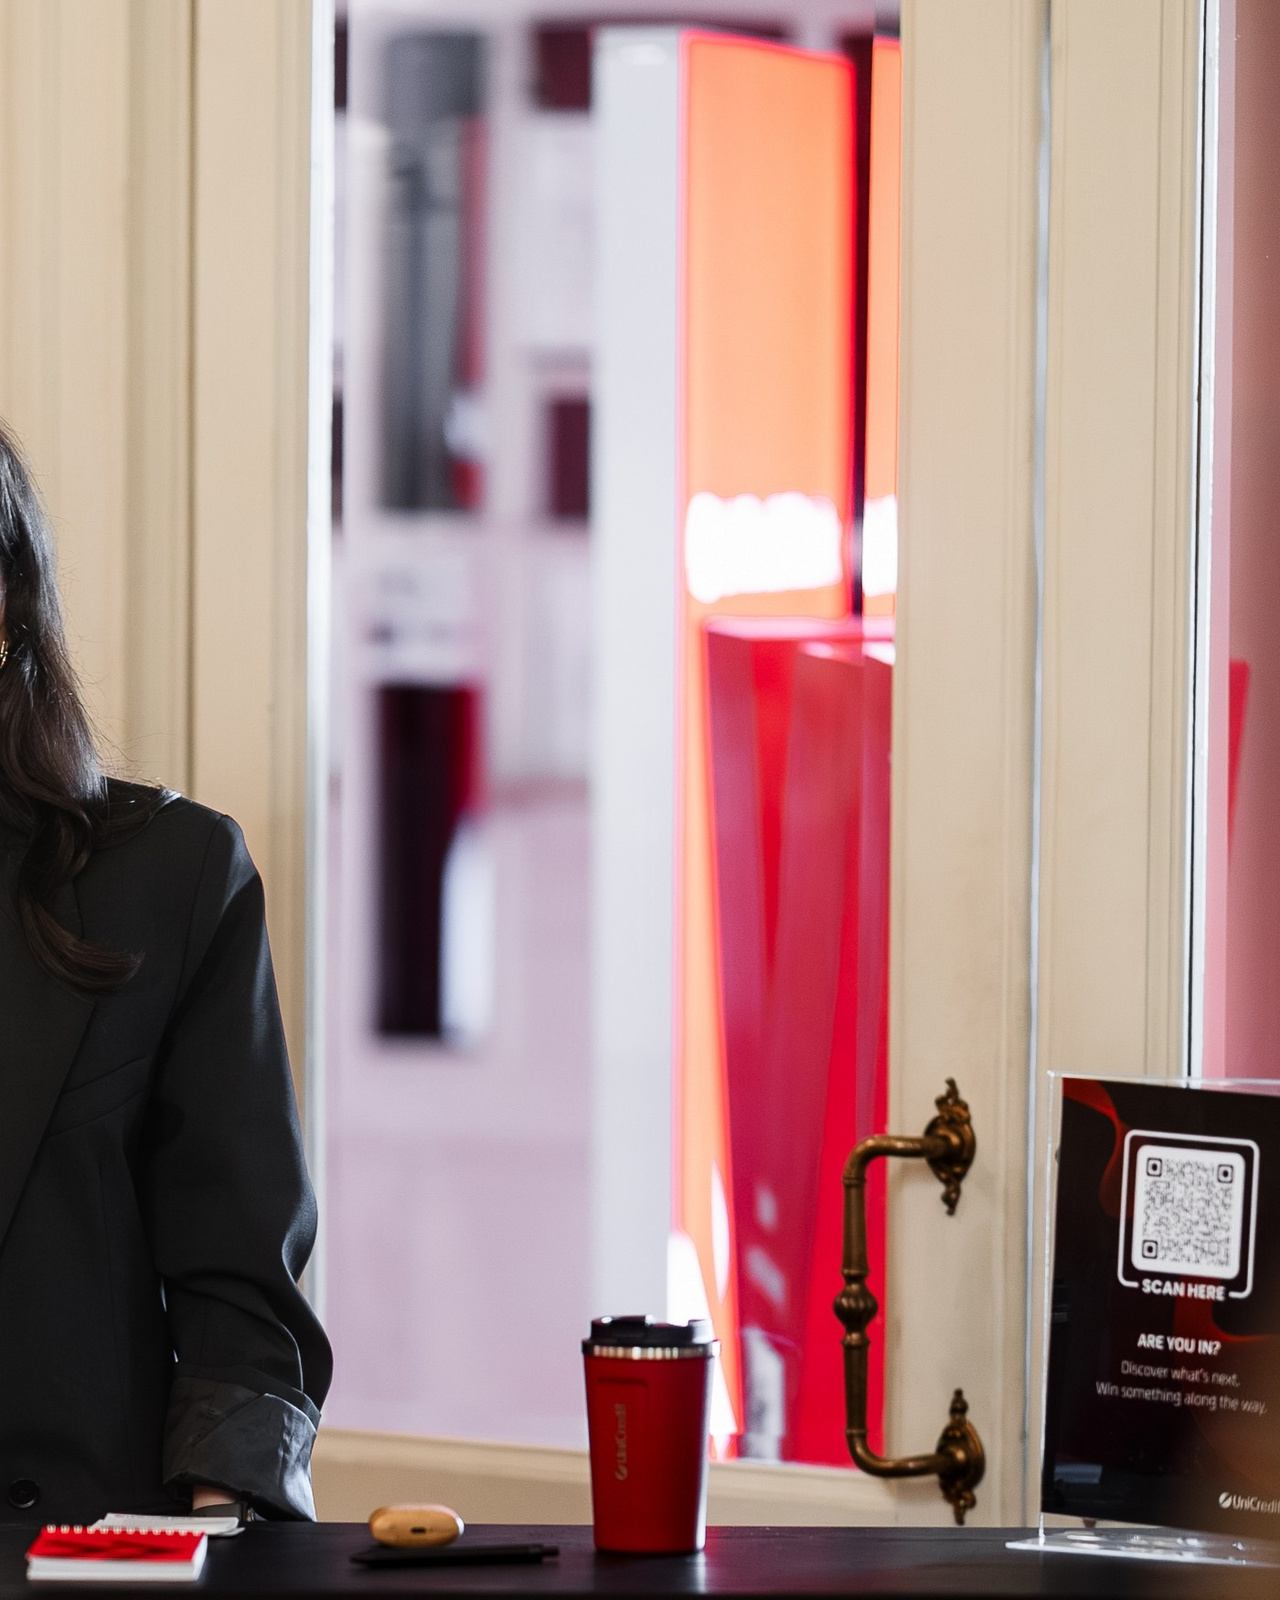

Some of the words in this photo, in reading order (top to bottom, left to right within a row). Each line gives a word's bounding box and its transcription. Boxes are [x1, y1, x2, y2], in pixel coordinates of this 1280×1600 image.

[1142, 1278, 1186, 1298] SCAN
[1187, 1283, 1226, 1301] HERE
[1137, 1333, 1165, 1350] ARE
[1167, 1336, 1196, 1354] YOU
[1198, 1340, 1221, 1356] IN?
[1121, 1360, 1169, 1378] Discover
[1211, 1373, 1241, 1388] next.
[1096, 1381, 1119, 1397] Win
[1121, 1385, 1183, 1407] something
[1184, 1392, 1217, 1412] along
[1219, 1395, 1239, 1411] the
